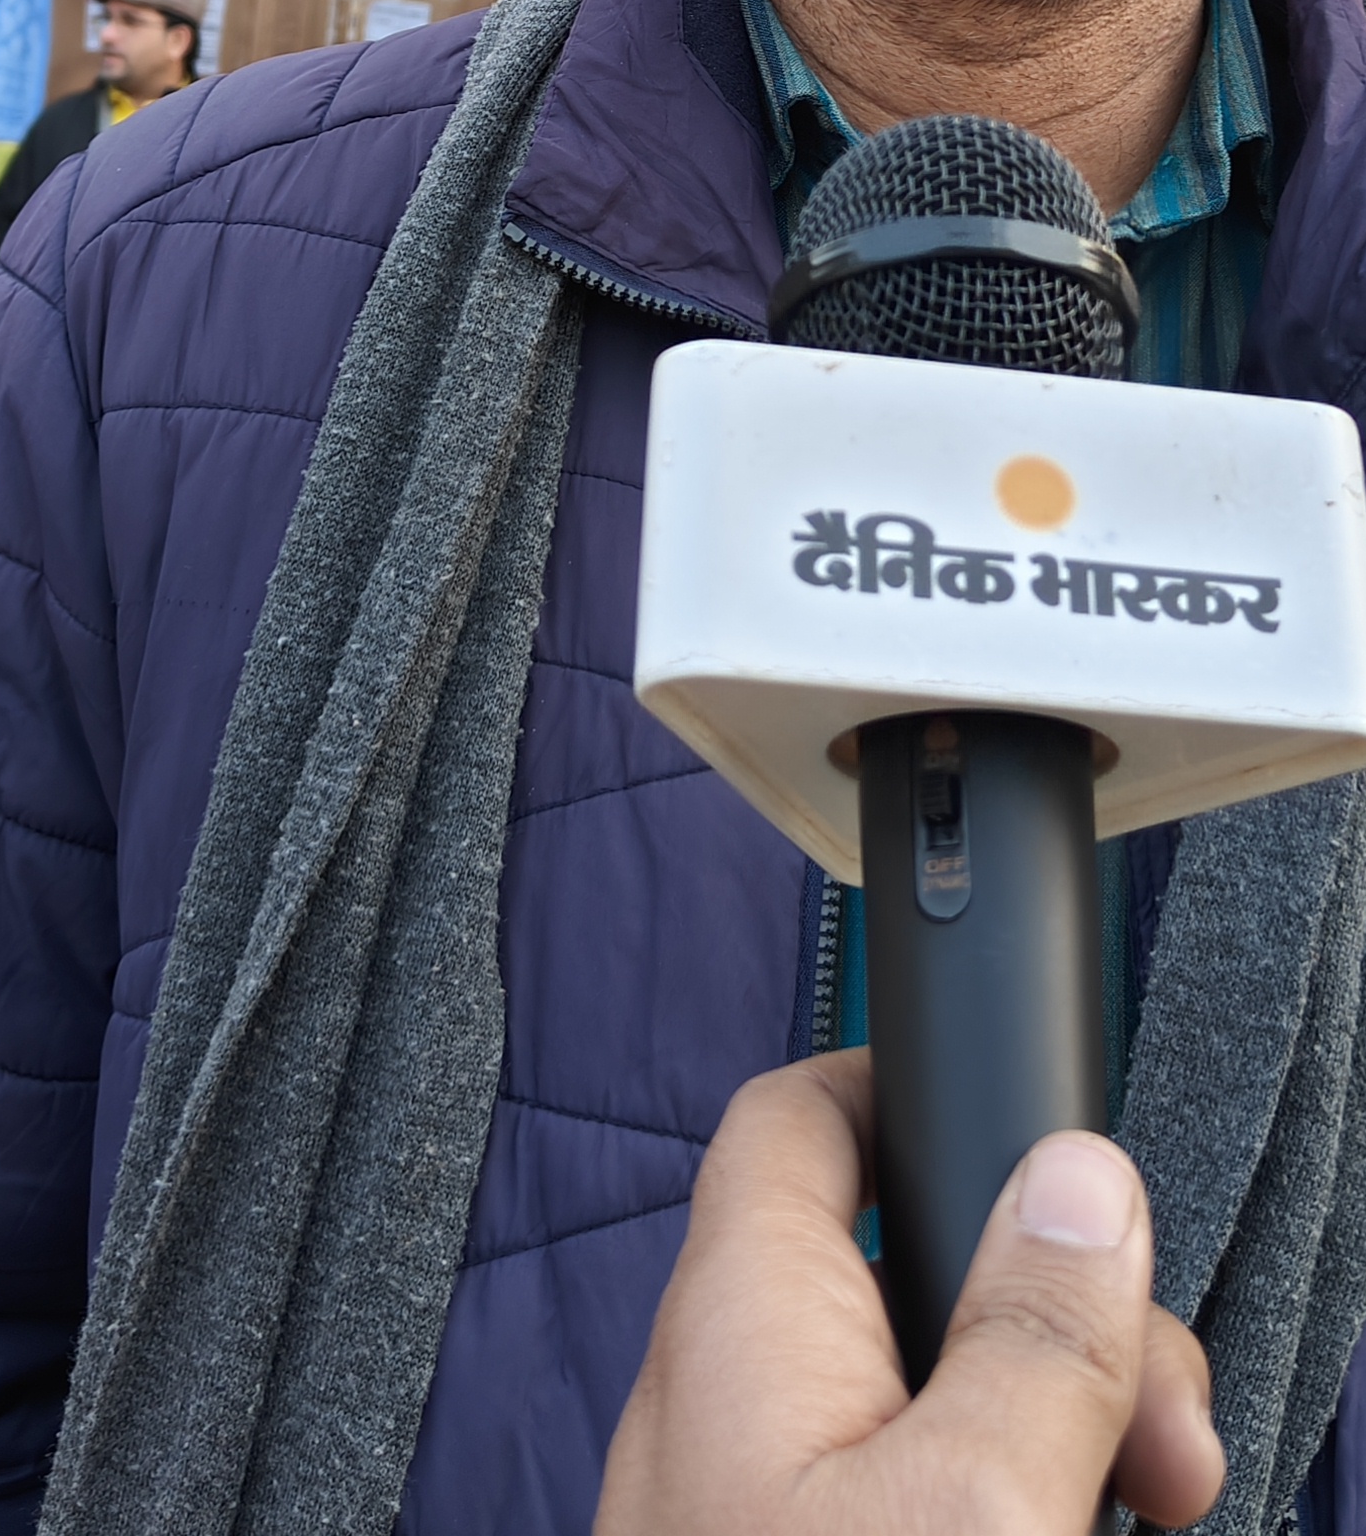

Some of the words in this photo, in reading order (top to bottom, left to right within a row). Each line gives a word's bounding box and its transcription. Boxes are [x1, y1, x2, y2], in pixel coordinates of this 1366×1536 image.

[790, 509, 1015, 604] दैनिक
[1028, 551, 1282, 634] भास्कर
[923, 855, 967, 875] OFF
